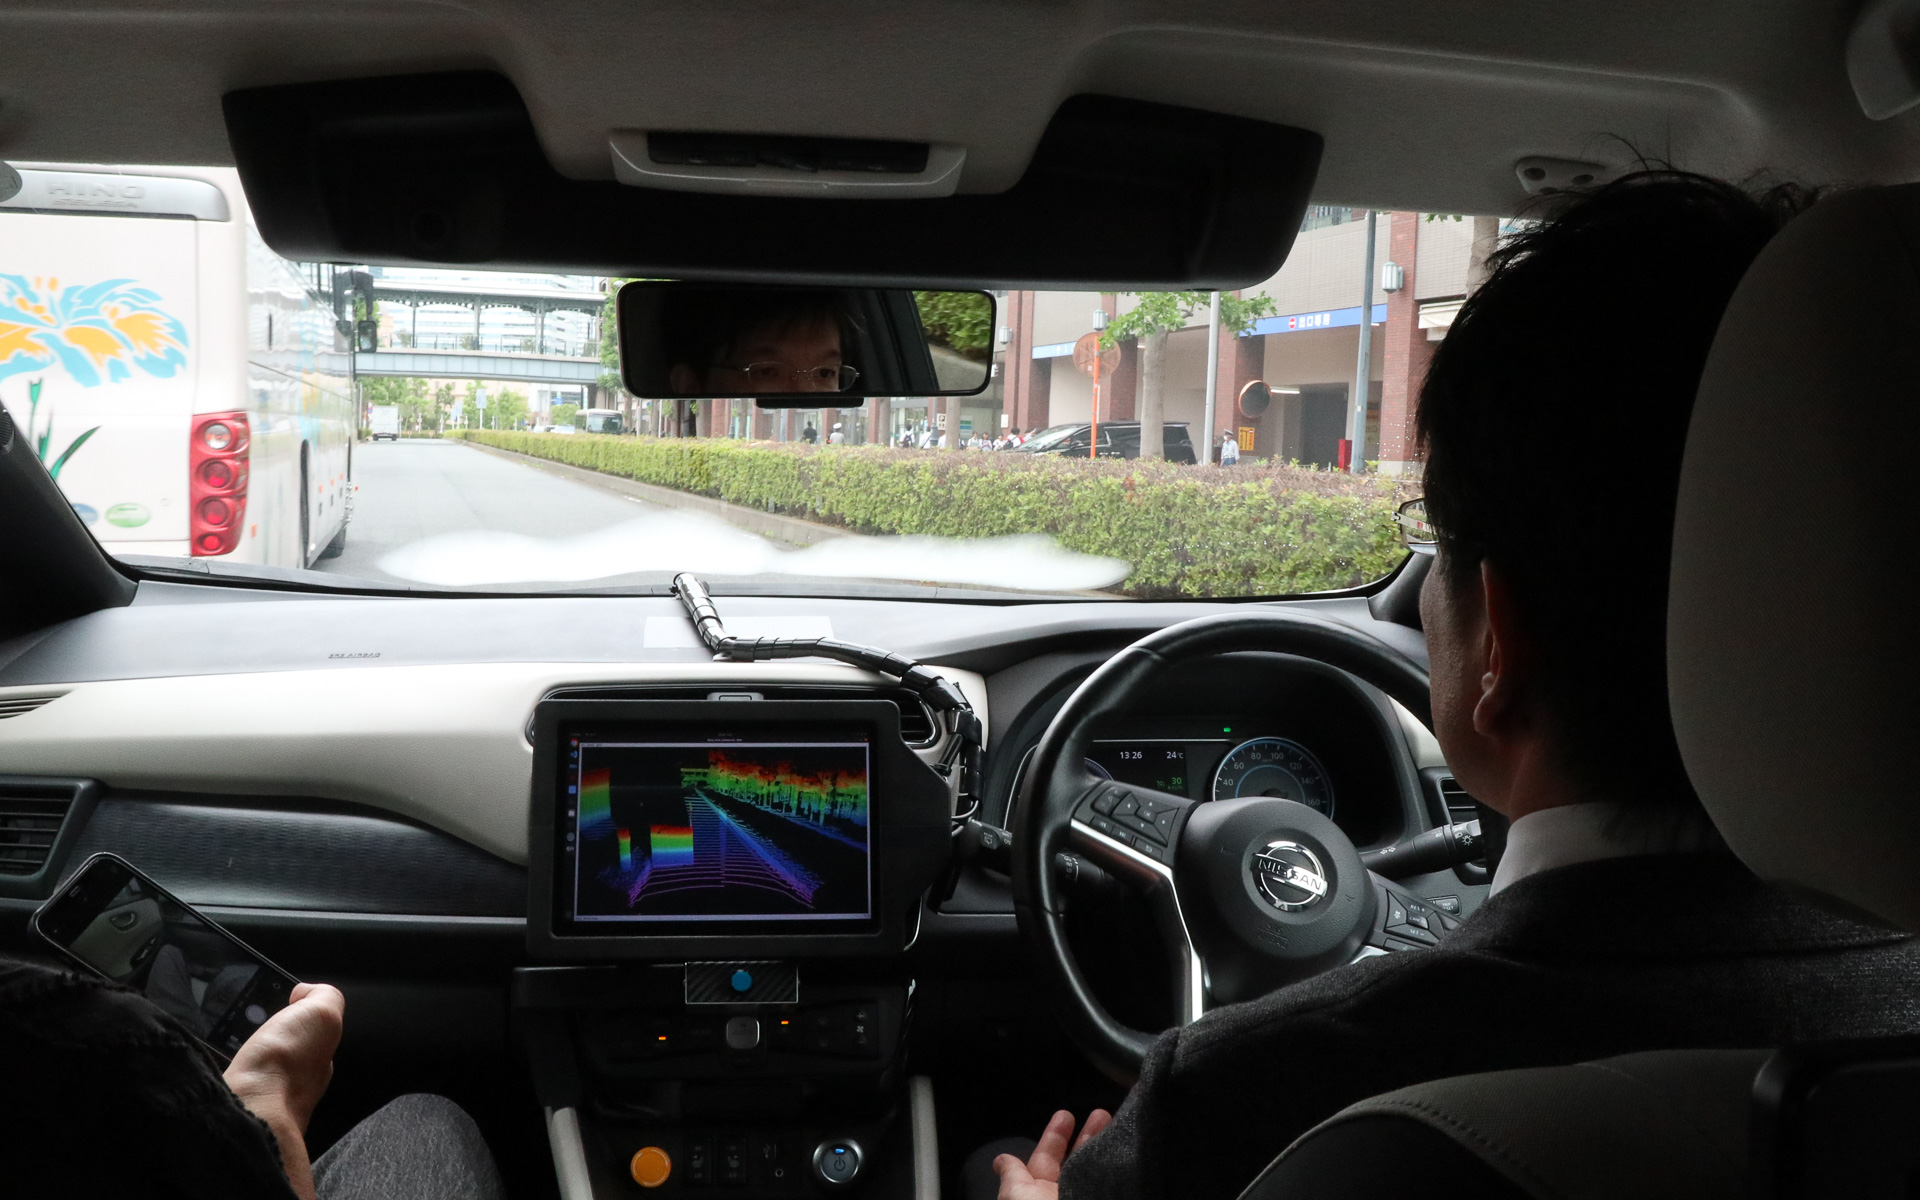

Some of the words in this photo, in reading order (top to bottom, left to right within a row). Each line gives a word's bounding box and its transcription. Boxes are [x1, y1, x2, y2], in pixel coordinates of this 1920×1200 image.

[47, 182, 145, 199] HINO
[1250, 752, 1262, 760] 80
[1270, 752, 1284, 760] 100
[1233, 762, 1245, 770] 60
[1289, 762, 1302, 770] 120
[1172, 777, 1183, 785] 30
[1222, 778, 1234, 786] 40
[1301, 777, 1314, 785] 140
[1307, 798, 1321, 806] 160
[1258, 858, 1322, 891] NISSAN
